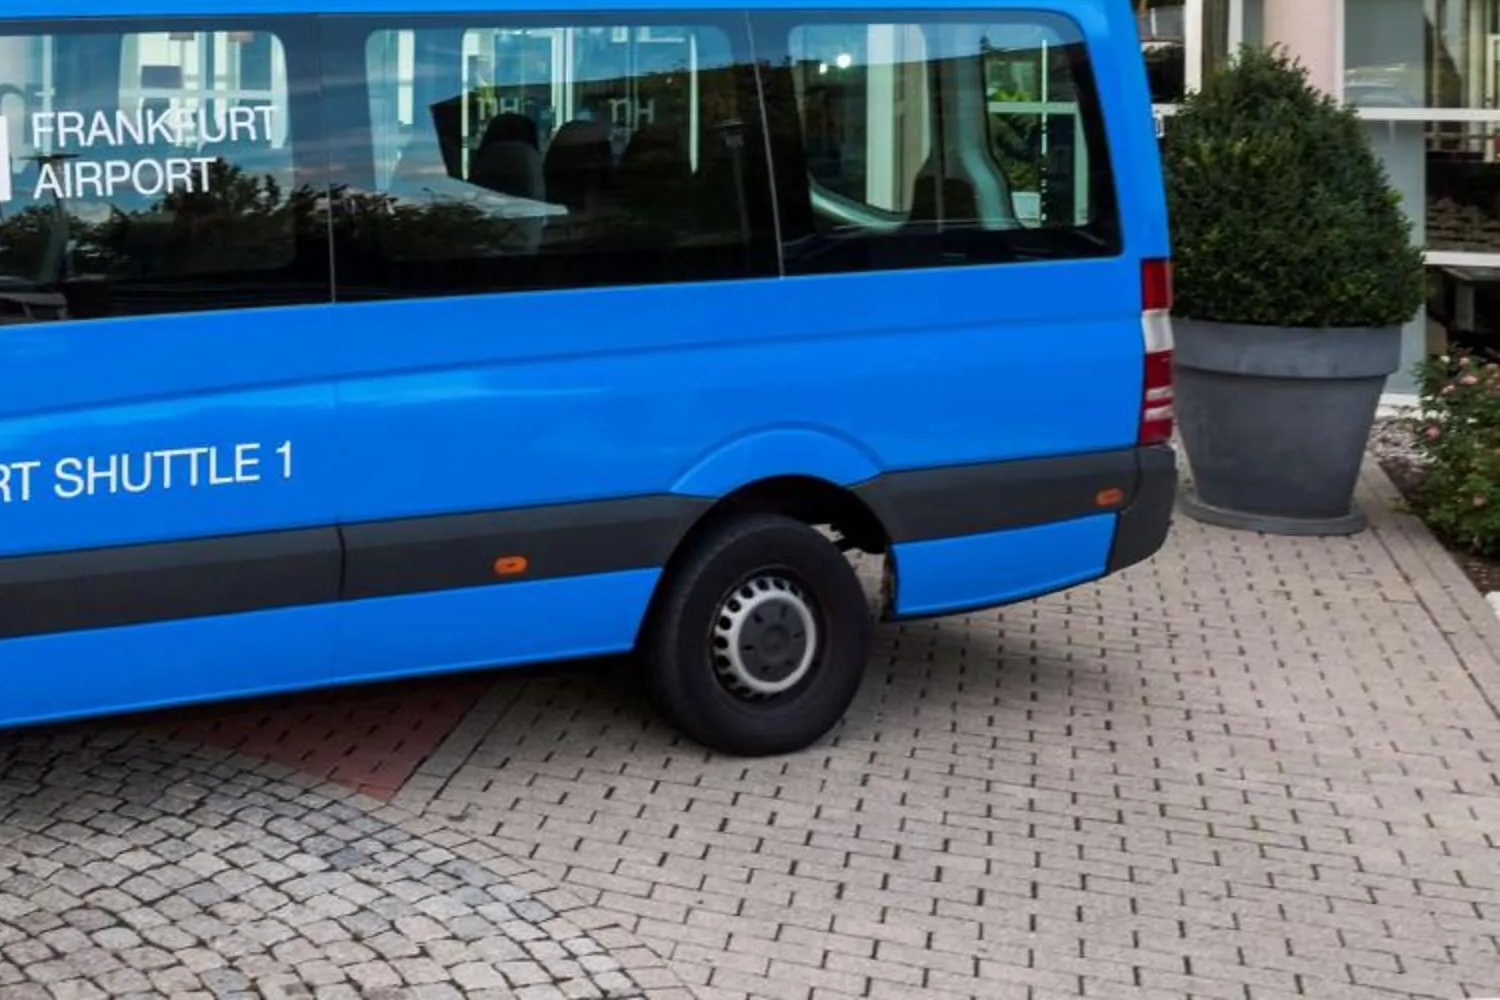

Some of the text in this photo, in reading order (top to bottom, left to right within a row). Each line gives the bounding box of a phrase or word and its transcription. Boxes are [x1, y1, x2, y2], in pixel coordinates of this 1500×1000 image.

[32, 105, 278, 148] FRANKFURT
[33, 156, 215, 200] AIRPORT
[54, 443, 260, 498] SHUTTLE
[275, 440, 292, 478] 1
